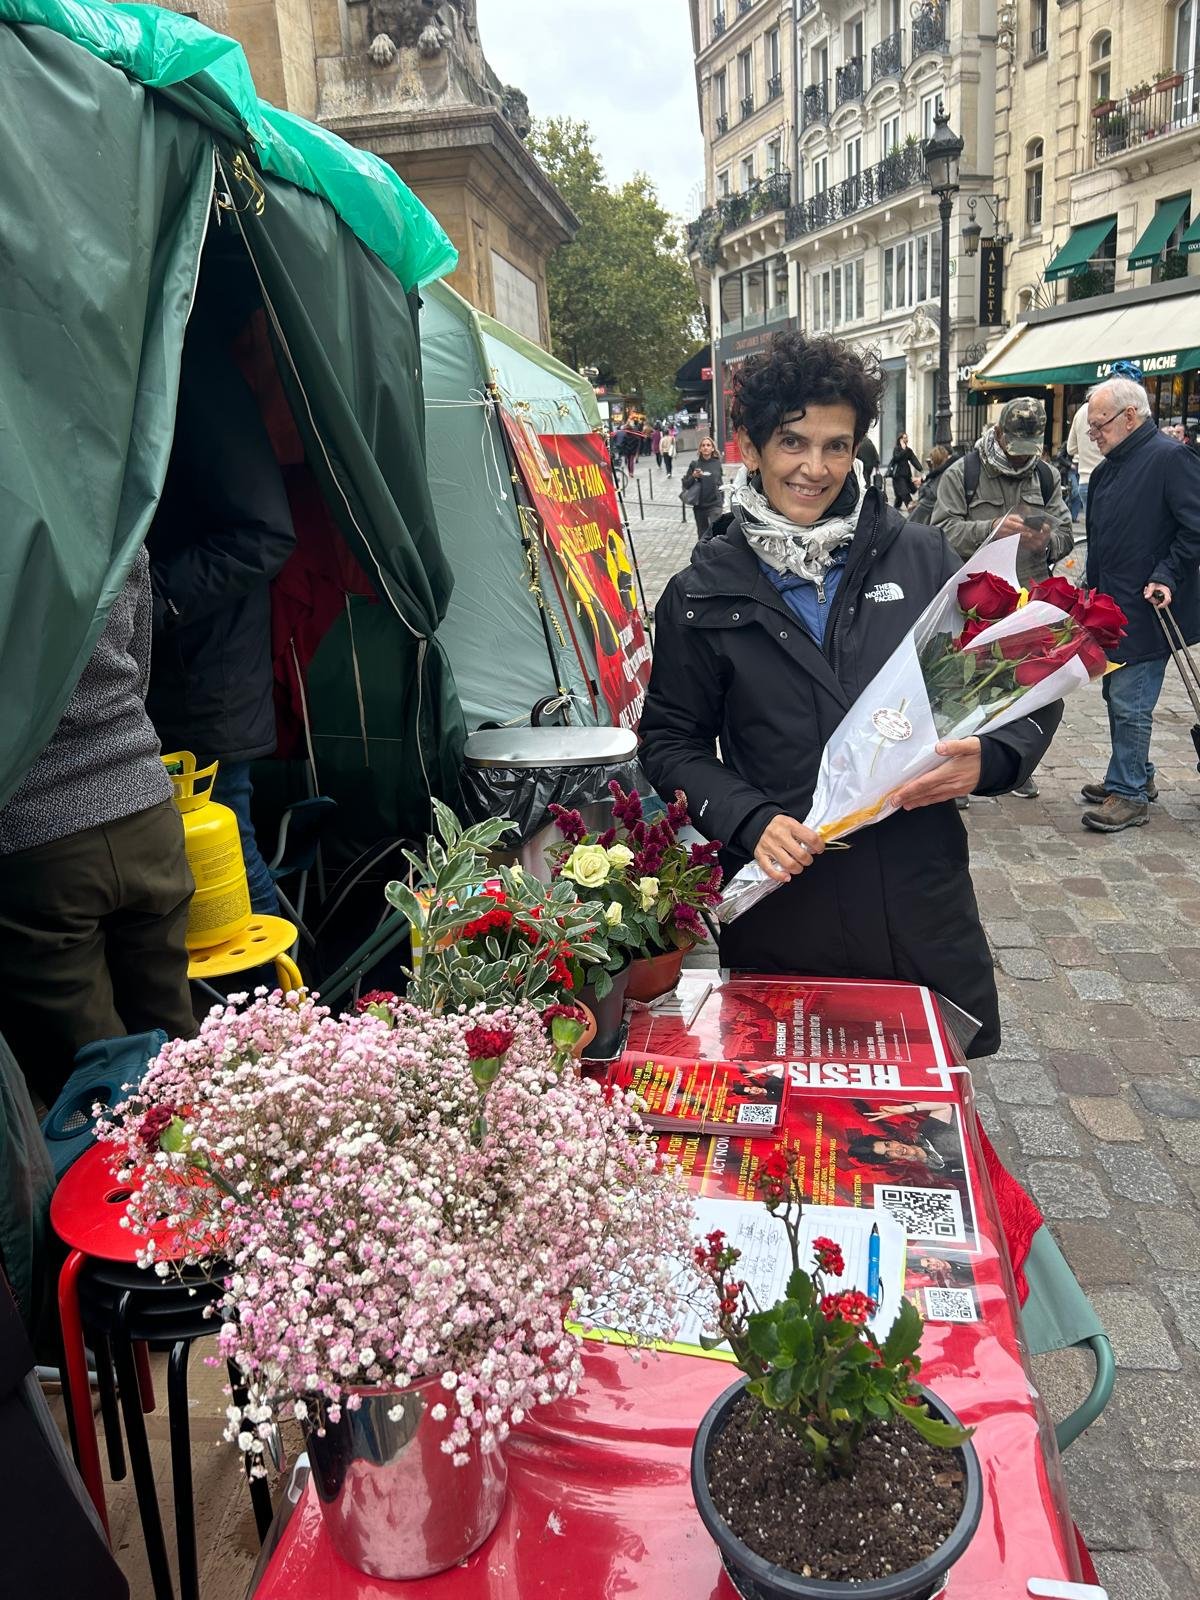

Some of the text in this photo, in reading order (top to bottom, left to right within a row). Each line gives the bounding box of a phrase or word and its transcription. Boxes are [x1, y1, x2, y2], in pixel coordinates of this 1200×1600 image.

[988, 251, 996, 322] ALLETY
[1142, 355, 1177, 371] VACHE
[957, 366, 973, 381] HO
[562, 466, 580, 503] LA
[577, 463, 606, 499] FAIM
[865, 589, 890, 599] NORTH
[874, 583, 890, 592] THE
[668, 1134, 684, 1152] FIGHT
[715, 1136, 731, 1156] NOW
[743, 1146, 752, 1155] AND
[681, 1137, 700, 1171] POLITICAL
[711, 1156, 726, 1176] ACT
[740, 1155, 750, 1175] OFFICIALS
[813, 1169, 822, 1196] RESISTANCE
[854, 1174, 862, 1196] PETITION
